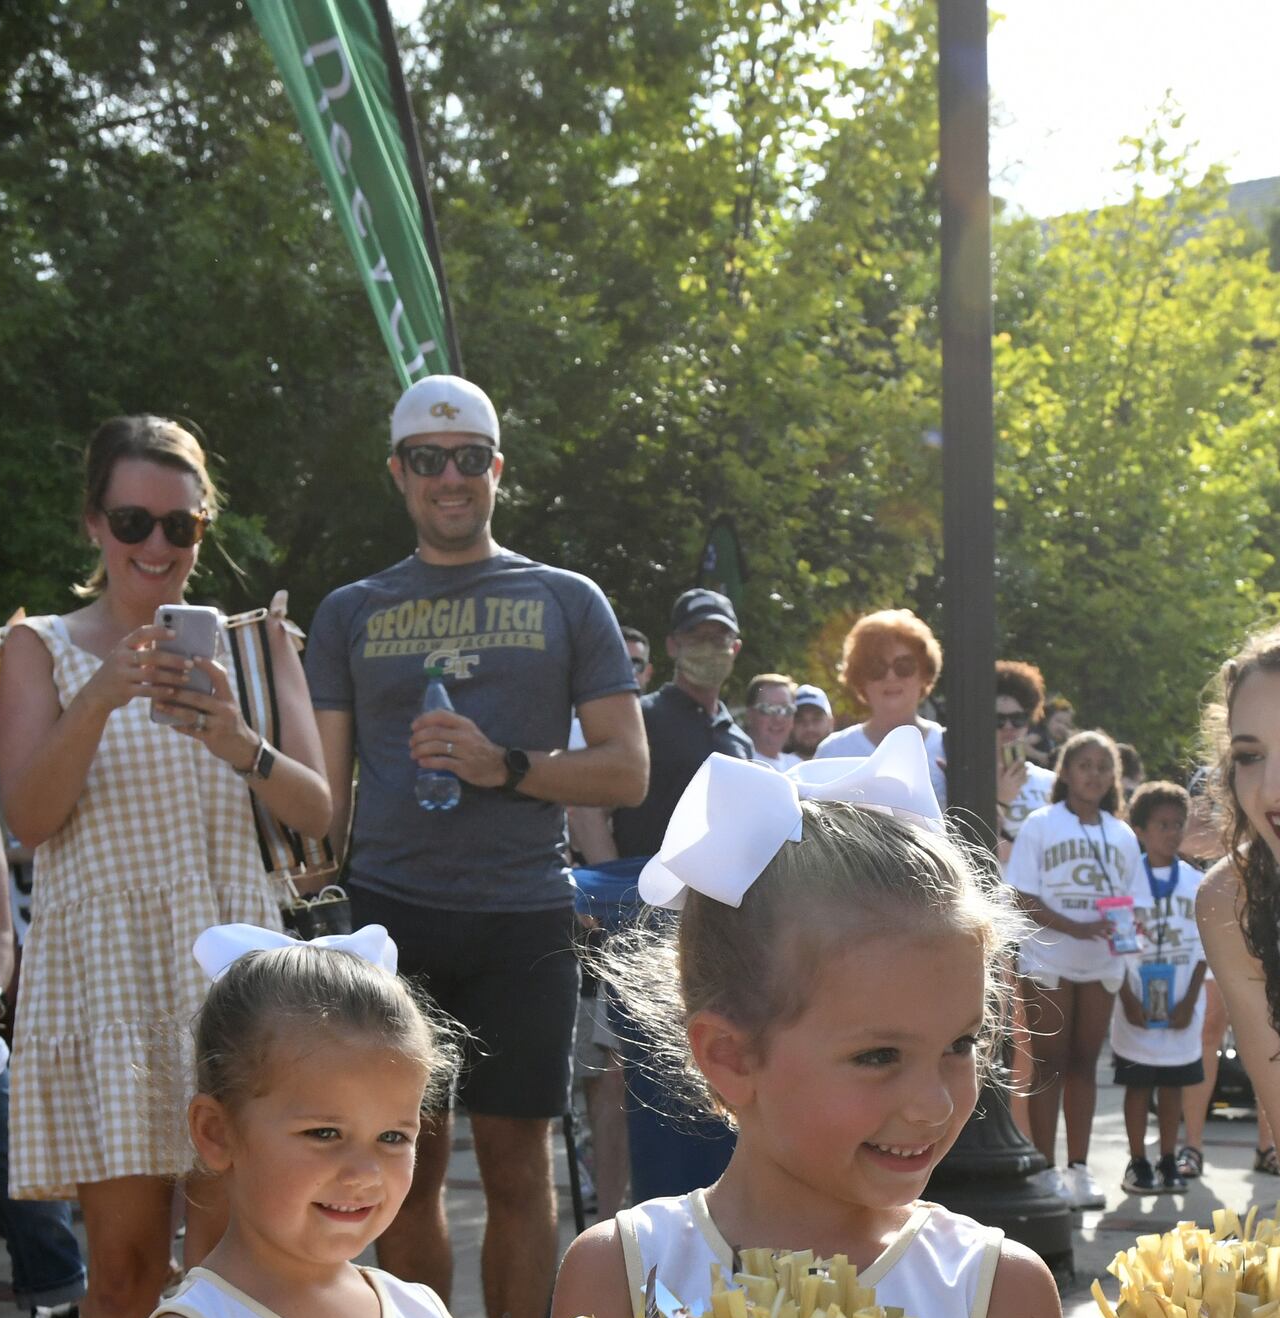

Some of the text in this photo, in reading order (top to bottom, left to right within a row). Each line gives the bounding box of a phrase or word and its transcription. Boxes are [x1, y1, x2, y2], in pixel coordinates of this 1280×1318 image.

[366, 596, 546, 641] GEORGIA TECH
[373, 633, 533, 655] YELLOW JACKETS
[423, 649, 481, 680] GT
